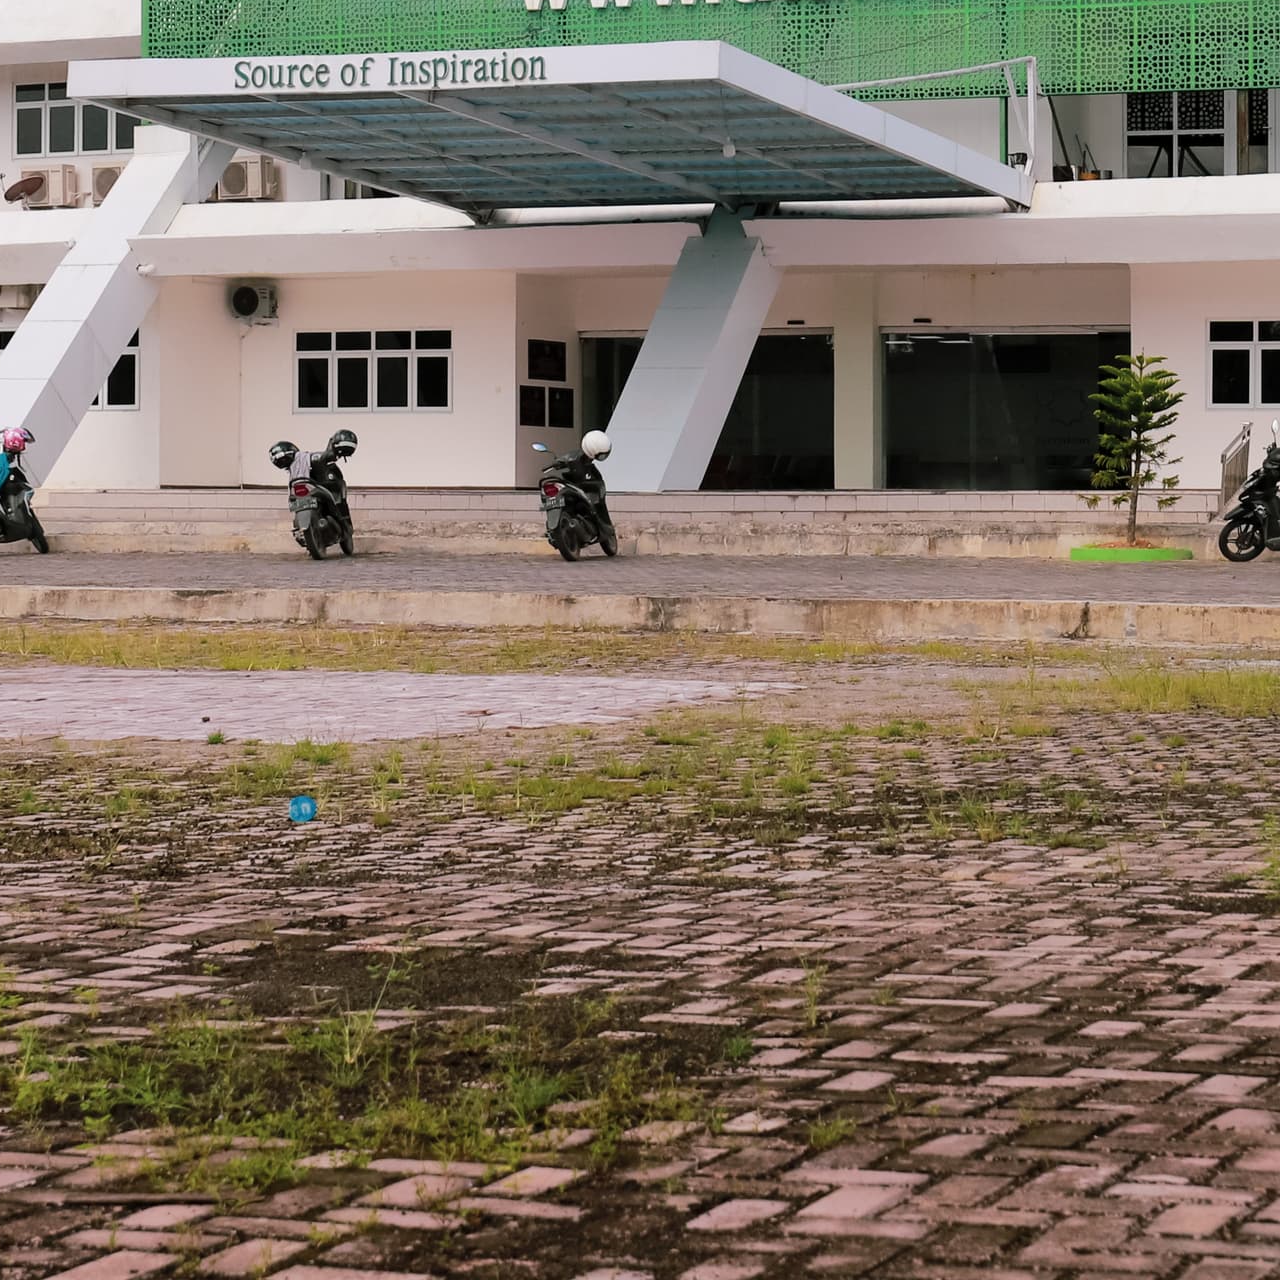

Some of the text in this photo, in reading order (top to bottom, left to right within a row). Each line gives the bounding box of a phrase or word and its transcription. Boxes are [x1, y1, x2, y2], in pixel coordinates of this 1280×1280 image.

[234, 50, 547, 89] Source of Inspiration
